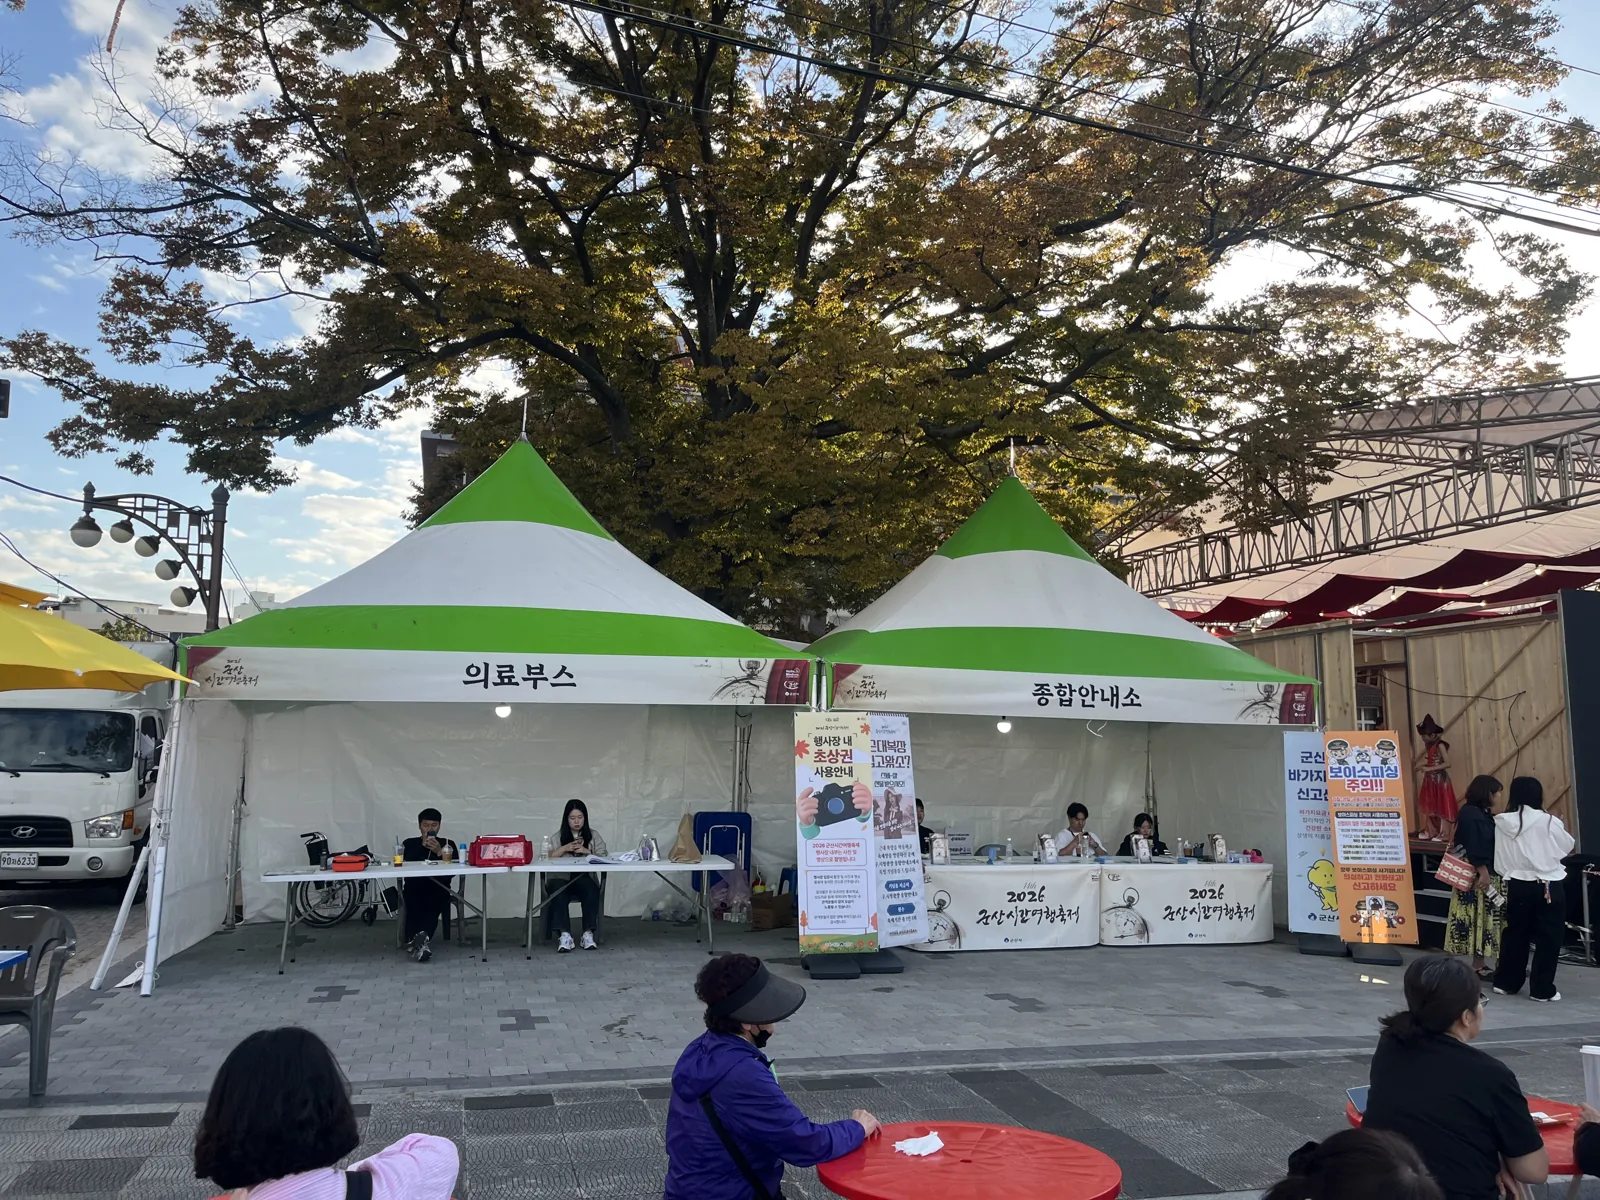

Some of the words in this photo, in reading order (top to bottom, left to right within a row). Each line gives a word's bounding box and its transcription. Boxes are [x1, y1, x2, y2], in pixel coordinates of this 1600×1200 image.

[463, 661, 577, 690] 의료부스
[1031, 682, 1142, 710] 종합안내소
[813, 735, 841, 748] 행사장
[843, 735, 853, 748] 내
[813, 749, 854, 765] 초상권
[814, 766, 854, 779] 사용안내
[1329, 765, 1399, 780] 보이스피싱
[1346, 779, 1383, 792] 주의!!
[1343, 873, 1373, 881] 의심하고!
[1006, 886, 1046, 903] 2026
[1188, 884, 1225, 900] 2026
[1352, 882, 1398, 891] 신고하세요
[976, 905, 1080, 926] 군산시간여행축제
[1162, 903, 1256, 922] 군산시간여행축제
